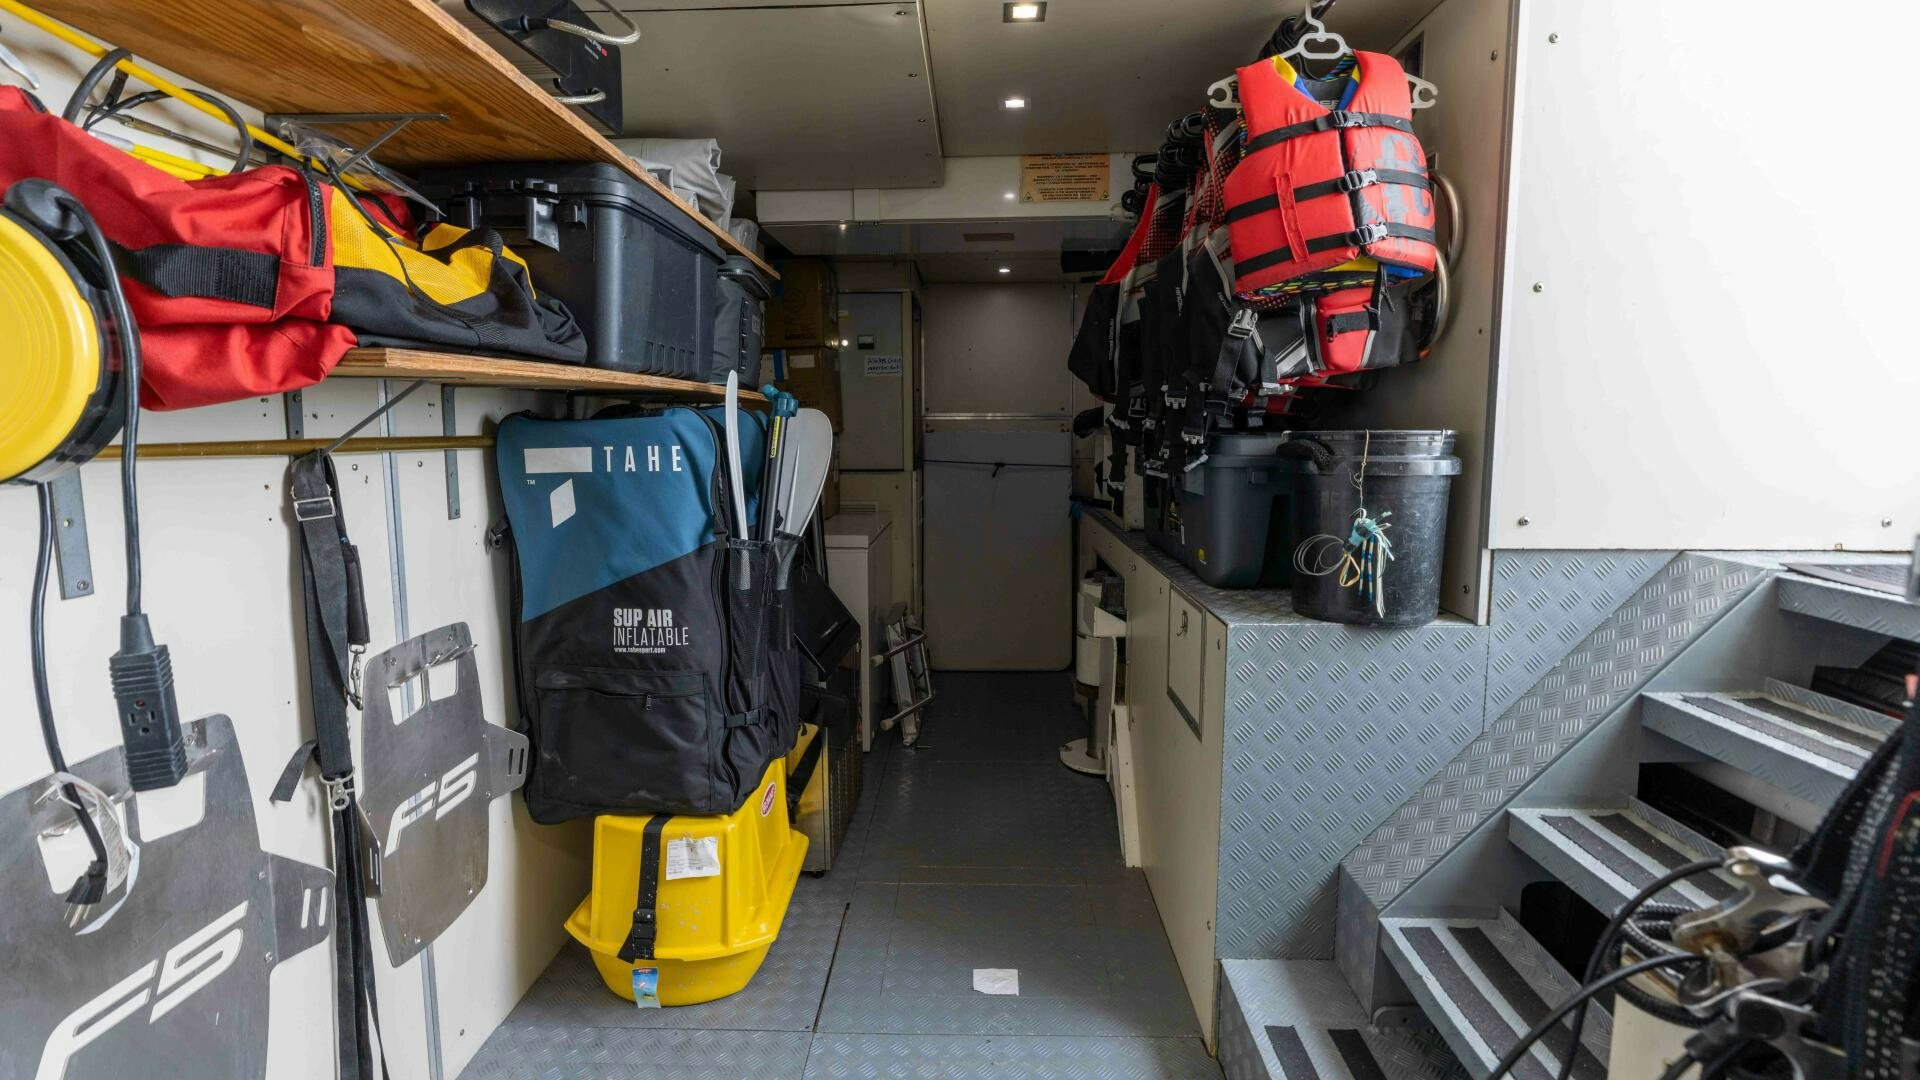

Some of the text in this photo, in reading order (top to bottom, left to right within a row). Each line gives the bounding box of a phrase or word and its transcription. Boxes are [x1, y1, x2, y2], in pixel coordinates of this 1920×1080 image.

[604, 445, 682, 473] TAHE
[613, 607, 673, 627] SUP AIR
[613, 627, 689, 646] INFLATABLE
